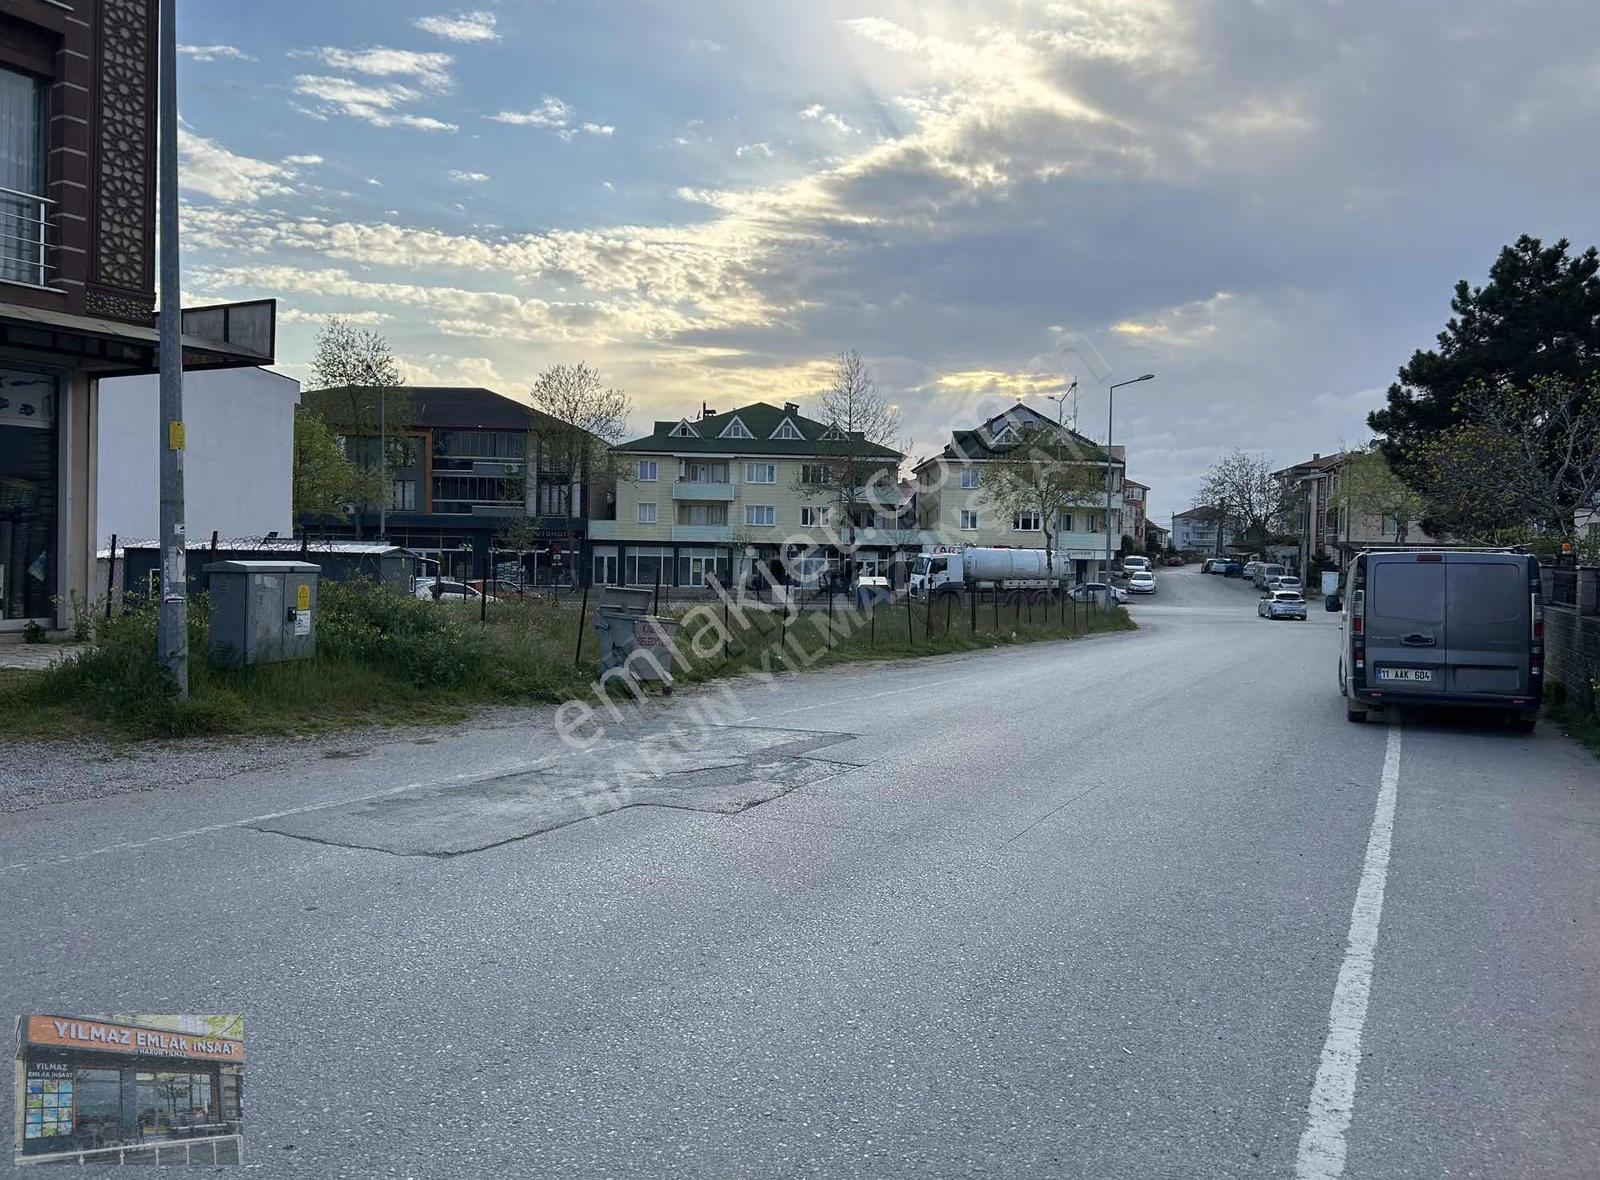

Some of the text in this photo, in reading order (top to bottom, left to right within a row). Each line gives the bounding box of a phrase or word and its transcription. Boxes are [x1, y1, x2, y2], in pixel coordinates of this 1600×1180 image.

[1382, 670, 1429, 680] 11 AAK 604
